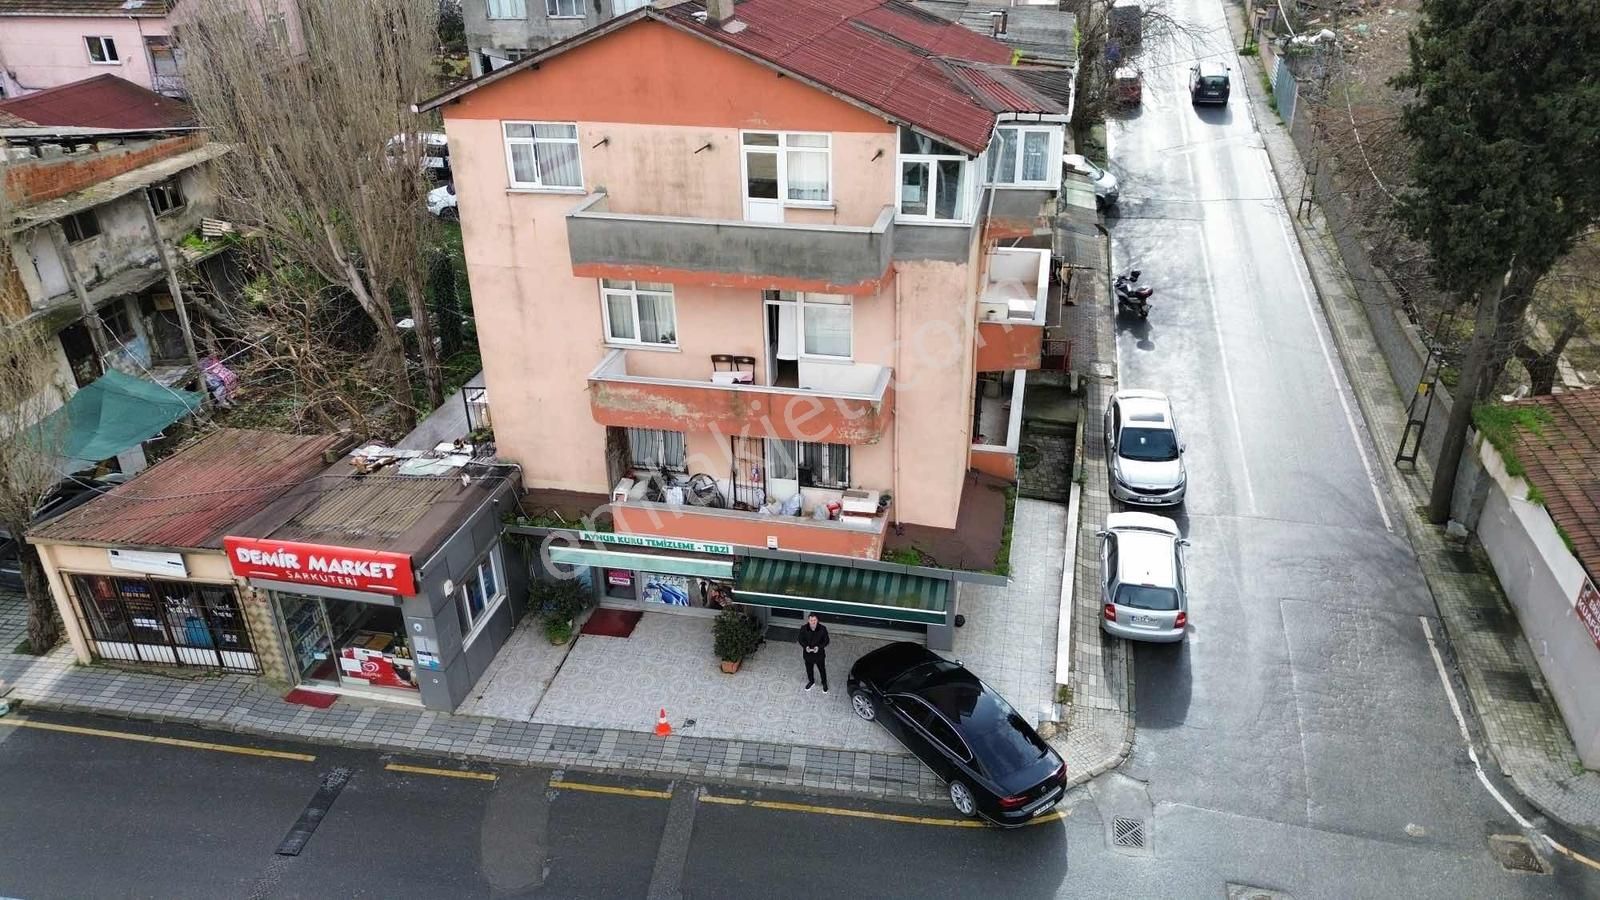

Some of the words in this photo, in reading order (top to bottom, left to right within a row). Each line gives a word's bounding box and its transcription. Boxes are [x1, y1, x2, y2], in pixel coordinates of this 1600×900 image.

[584, 533, 616, 543] AYNUR
[617, 536, 643, 545] KURU
[645, 539, 695, 551] TEMİZLEME
[703, 543, 730, 554] TERZİ
[236, 548, 301, 570] DEMİR
[308, 555, 396, 580] MARKET
[285, 570, 358, 587] SARKÜTERİ
[1577, 598, 1600, 642] KUAFÖ
